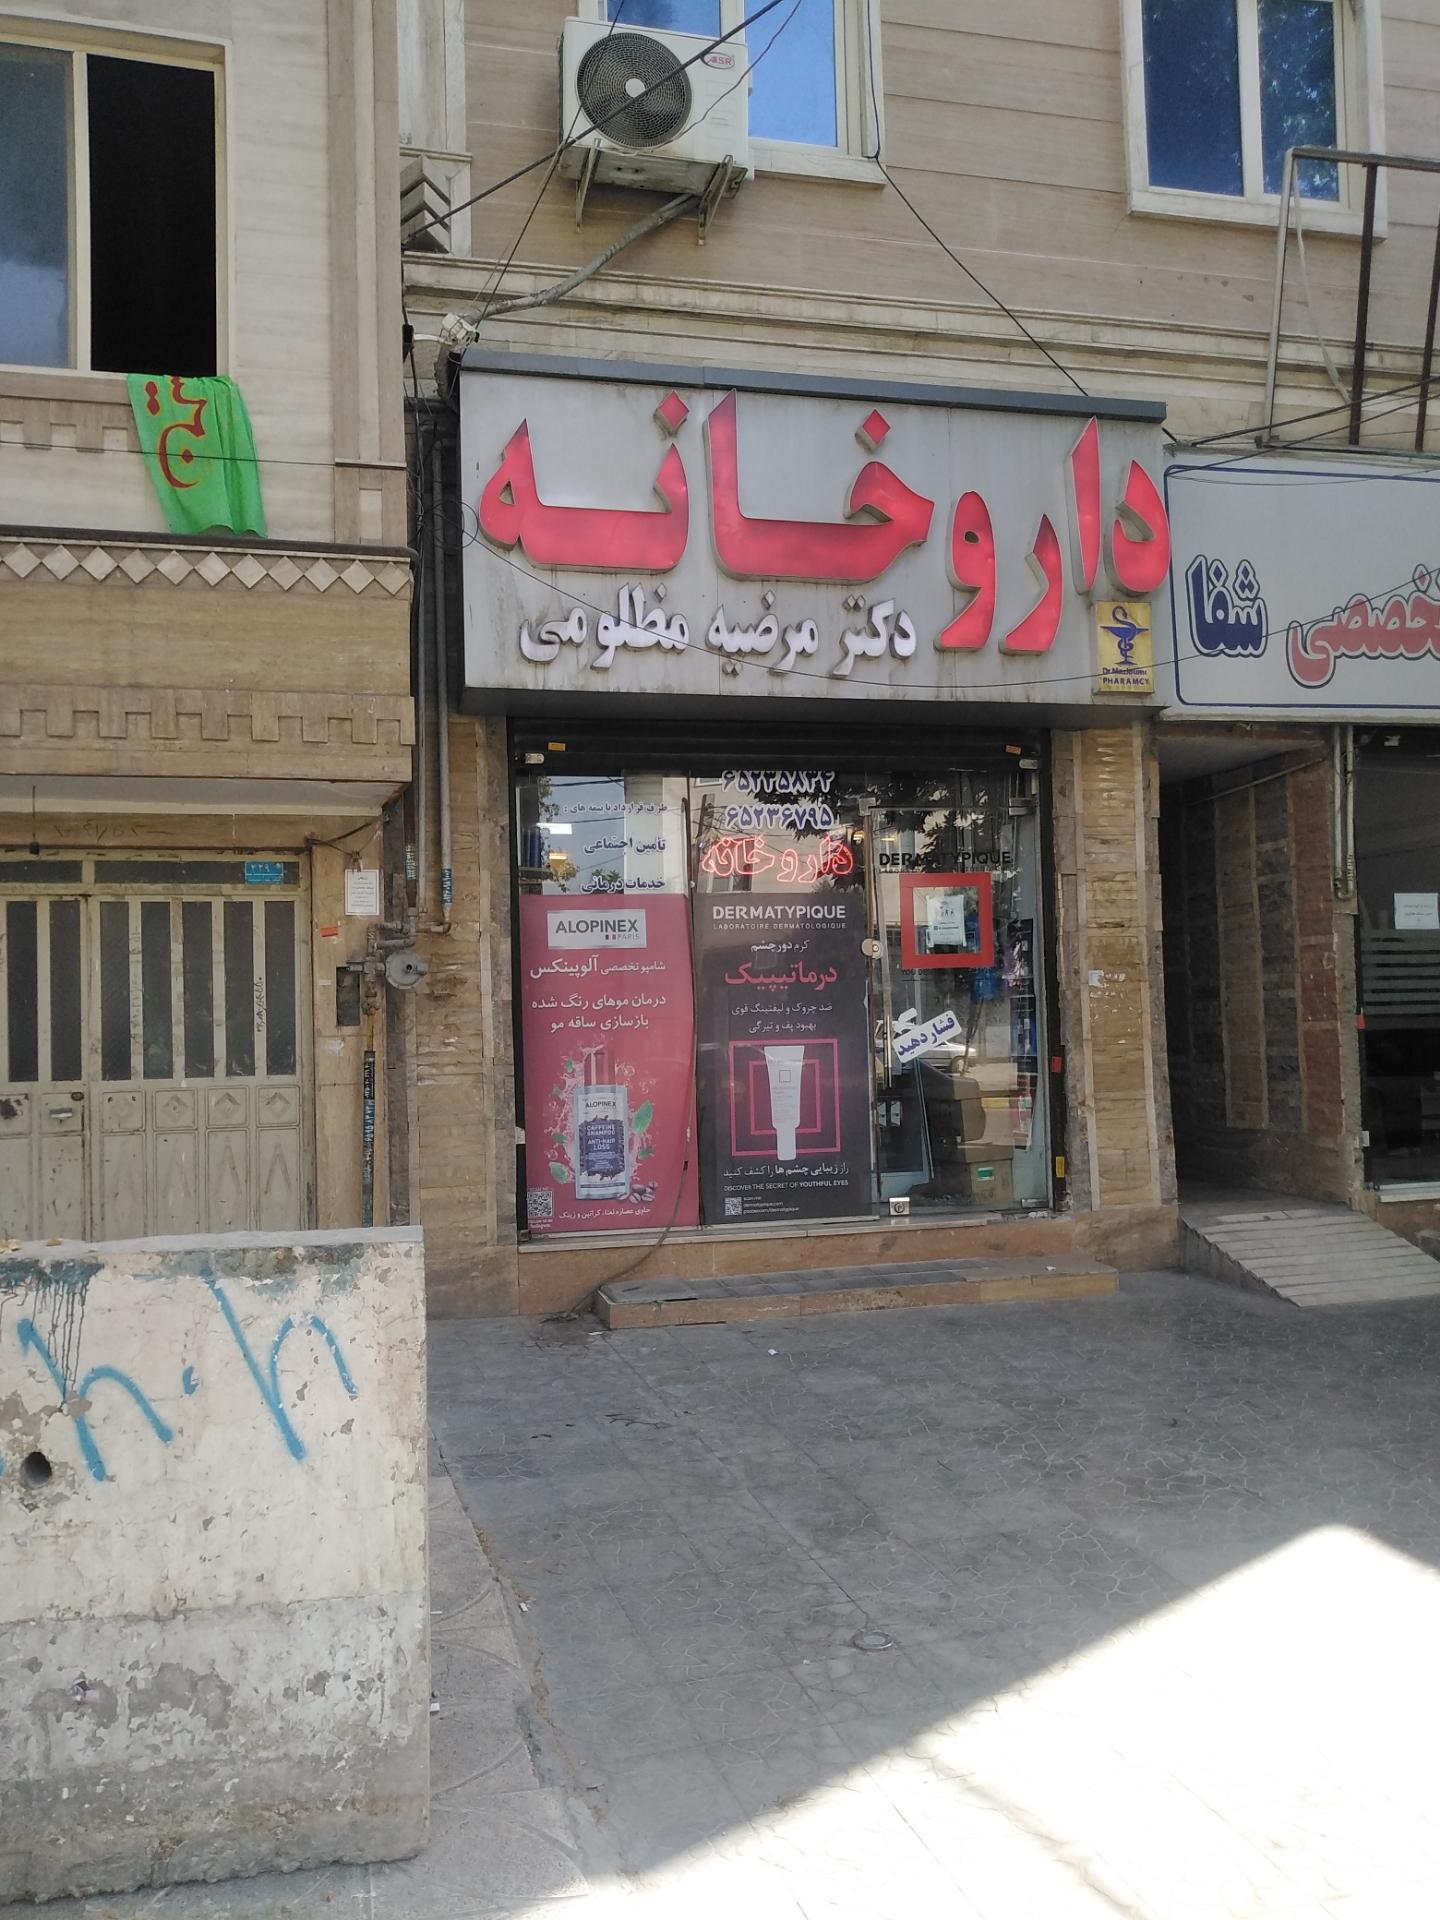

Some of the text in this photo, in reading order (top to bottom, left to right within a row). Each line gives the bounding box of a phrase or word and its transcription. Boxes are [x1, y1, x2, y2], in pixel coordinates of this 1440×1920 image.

[478, 387, 1170, 655] داروخانه
[519, 581, 917, 677] دکتر مرضیه مظلومی
[725, 803, 834, 830] ۶۵۲۳۶۷۹۵
[584, 835, 633, 856] اجتماعی
[702, 832, 854, 884] داروخانه
[581, 875, 666, 894] خدمات درمانی
[712, 905, 846, 920] DERMATYPIQUE
[555, 919, 639, 935] ALOPINEX
[750, 939, 811, 953] کرم دور چشم
[530, 954, 666, 979] شامپو تخصصی آلوپینکس
[724, 960, 838, 992] درماتیپیک
[531, 992, 667, 1010] درمان موهای رنگ شده
[791, 1002, 817, 1015] چروک
[818, 1002, 833, 1011] ضد
[731, 1003, 749, 1016] قوی
[550, 1021, 565, 1033] مو
[568, 1015, 597, 1028] ساقه
[749, 1021, 774, 1034] تیرگی
[795, 1022, 817, 1031] بهبود
[898, 1013, 955, 1056] فشار دهید
[785, 1163, 809, 1177] چشم
[810, 1162, 839, 1176] زیبایی
[723, 1184, 752, 1192] DISCOVER
[765, 1182, 789, 1190] SECRET
[799, 1180, 832, 1188] YOUTHFUL
